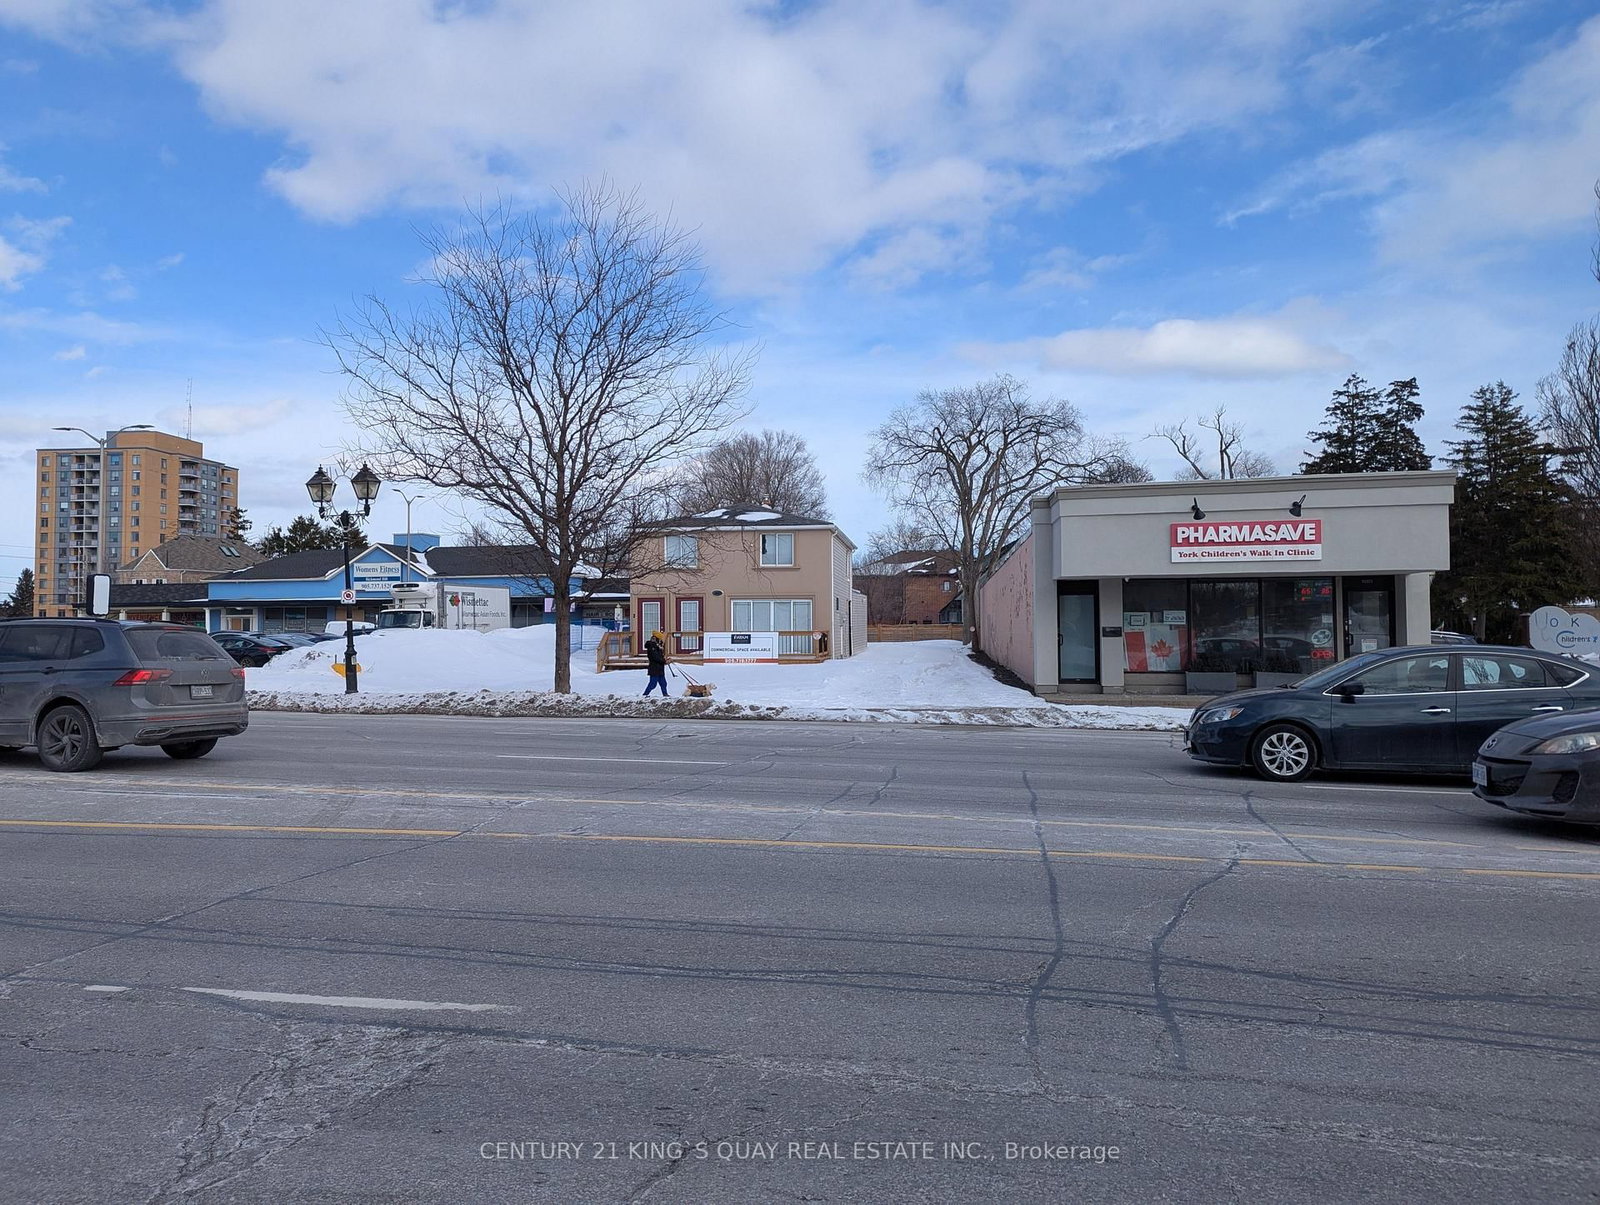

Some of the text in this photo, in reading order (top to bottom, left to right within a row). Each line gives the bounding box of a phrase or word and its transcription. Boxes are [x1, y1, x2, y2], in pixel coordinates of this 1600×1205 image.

[1177, 523, 1316, 543] PHARMASAVE
[1200, 550, 1247, 558] Children's
[1250, 549, 1272, 557] Walk
[355, 565, 378, 573] Womens
